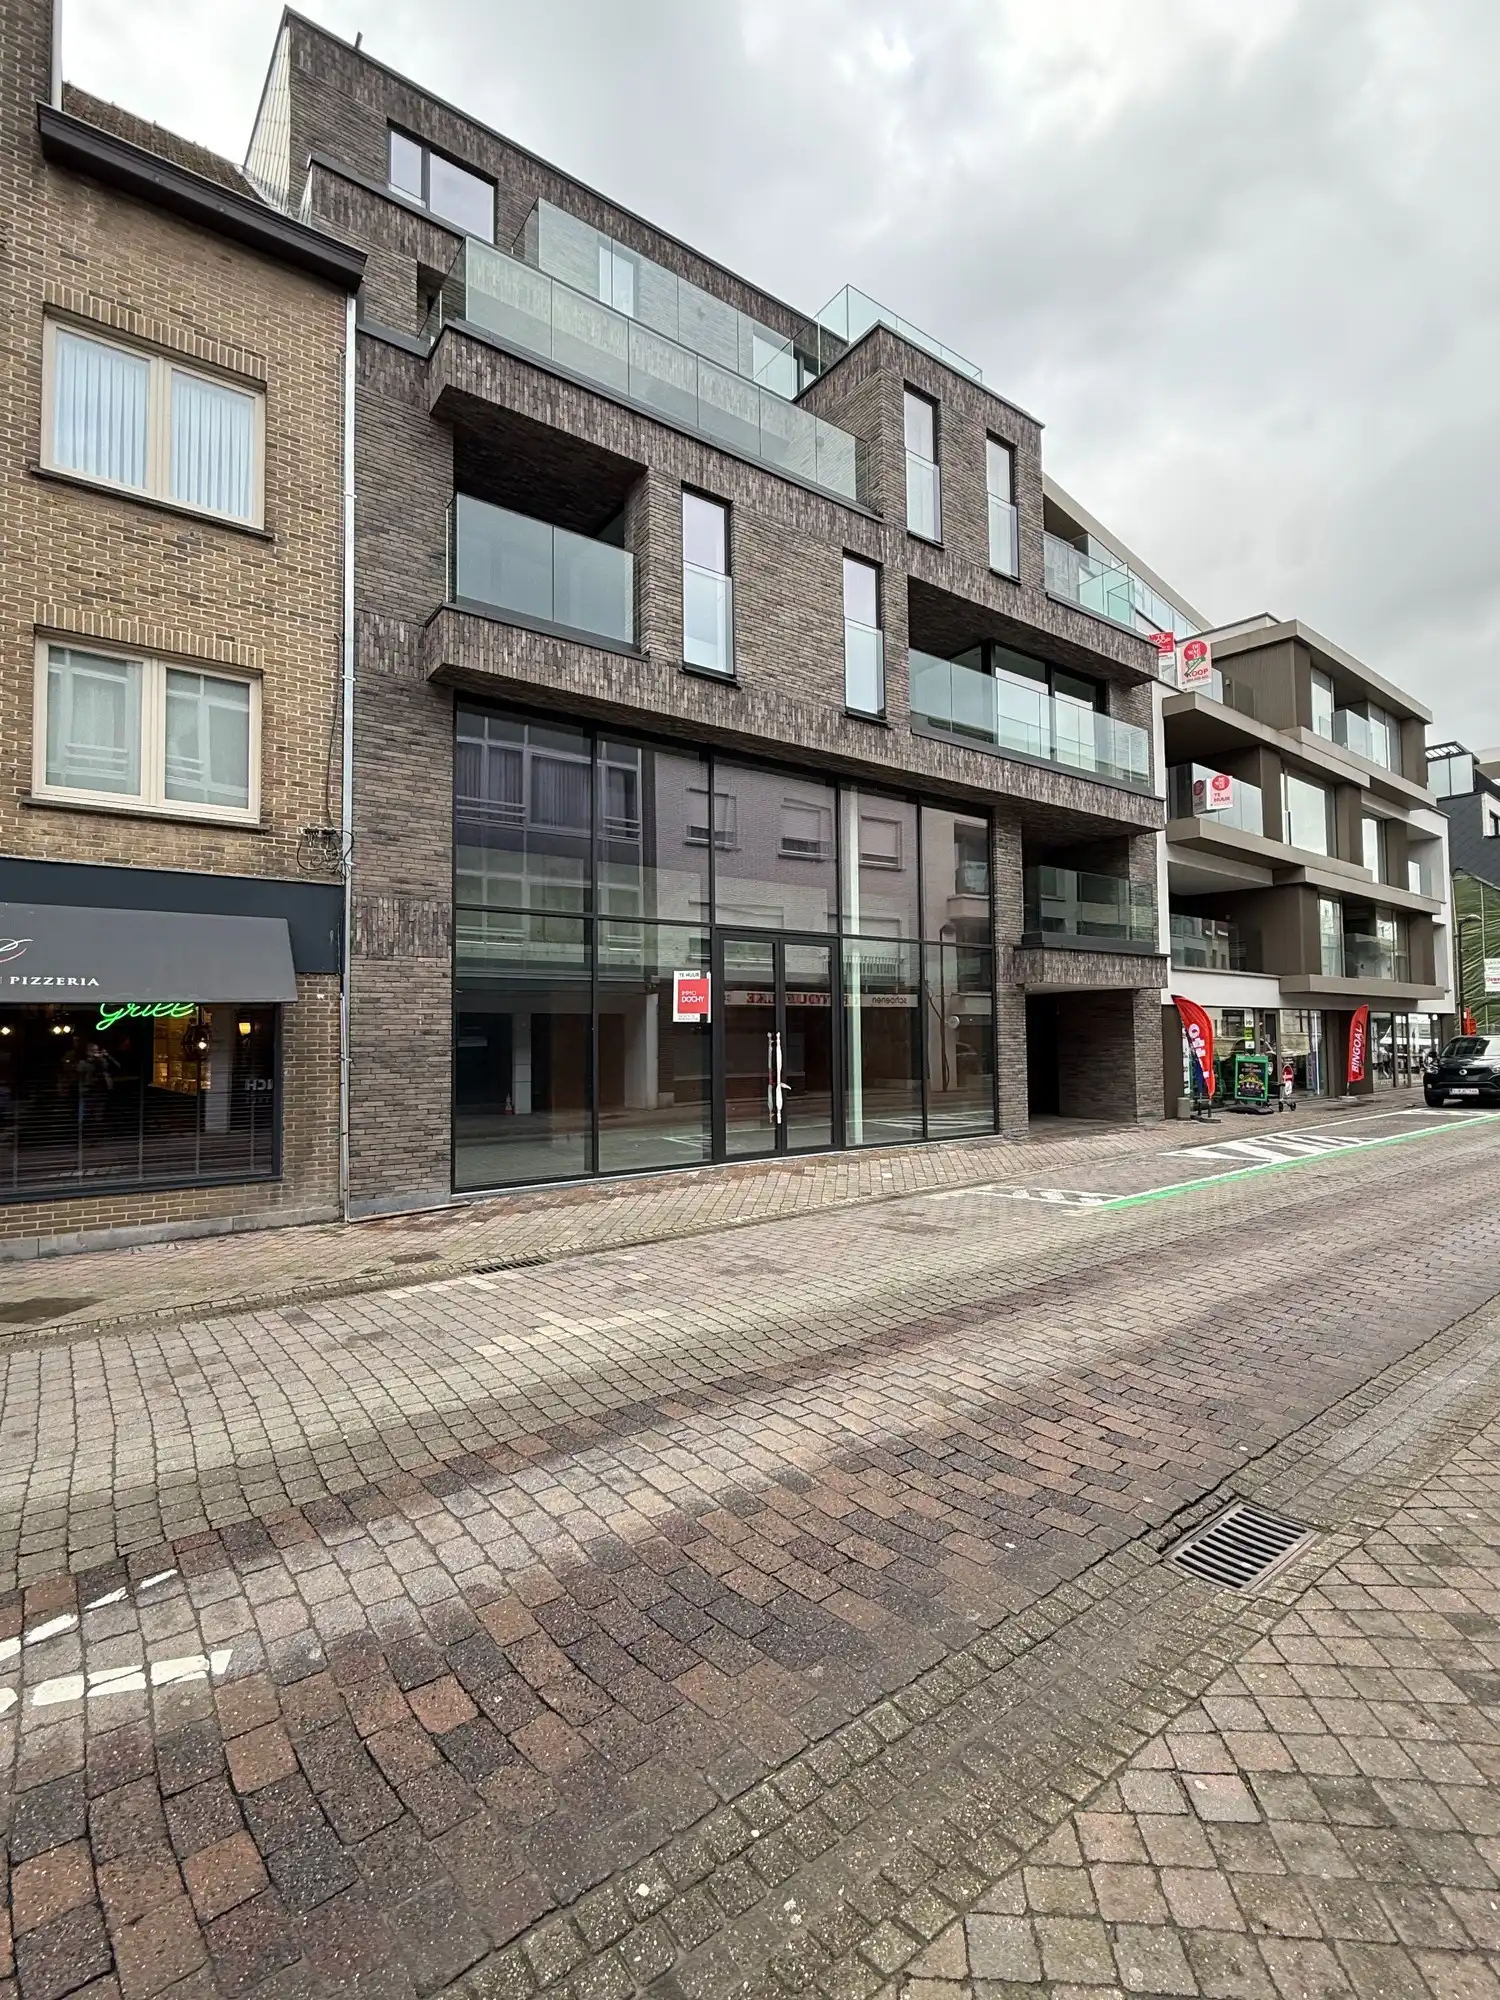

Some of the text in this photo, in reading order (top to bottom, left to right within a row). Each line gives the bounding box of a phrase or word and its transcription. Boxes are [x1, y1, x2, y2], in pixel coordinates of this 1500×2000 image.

[9, 976, 100, 987] PIZZERIA
[681, 995, 705, 1003] DOCHY
[1351, 1023, 1364, 1073] BINGOAL
